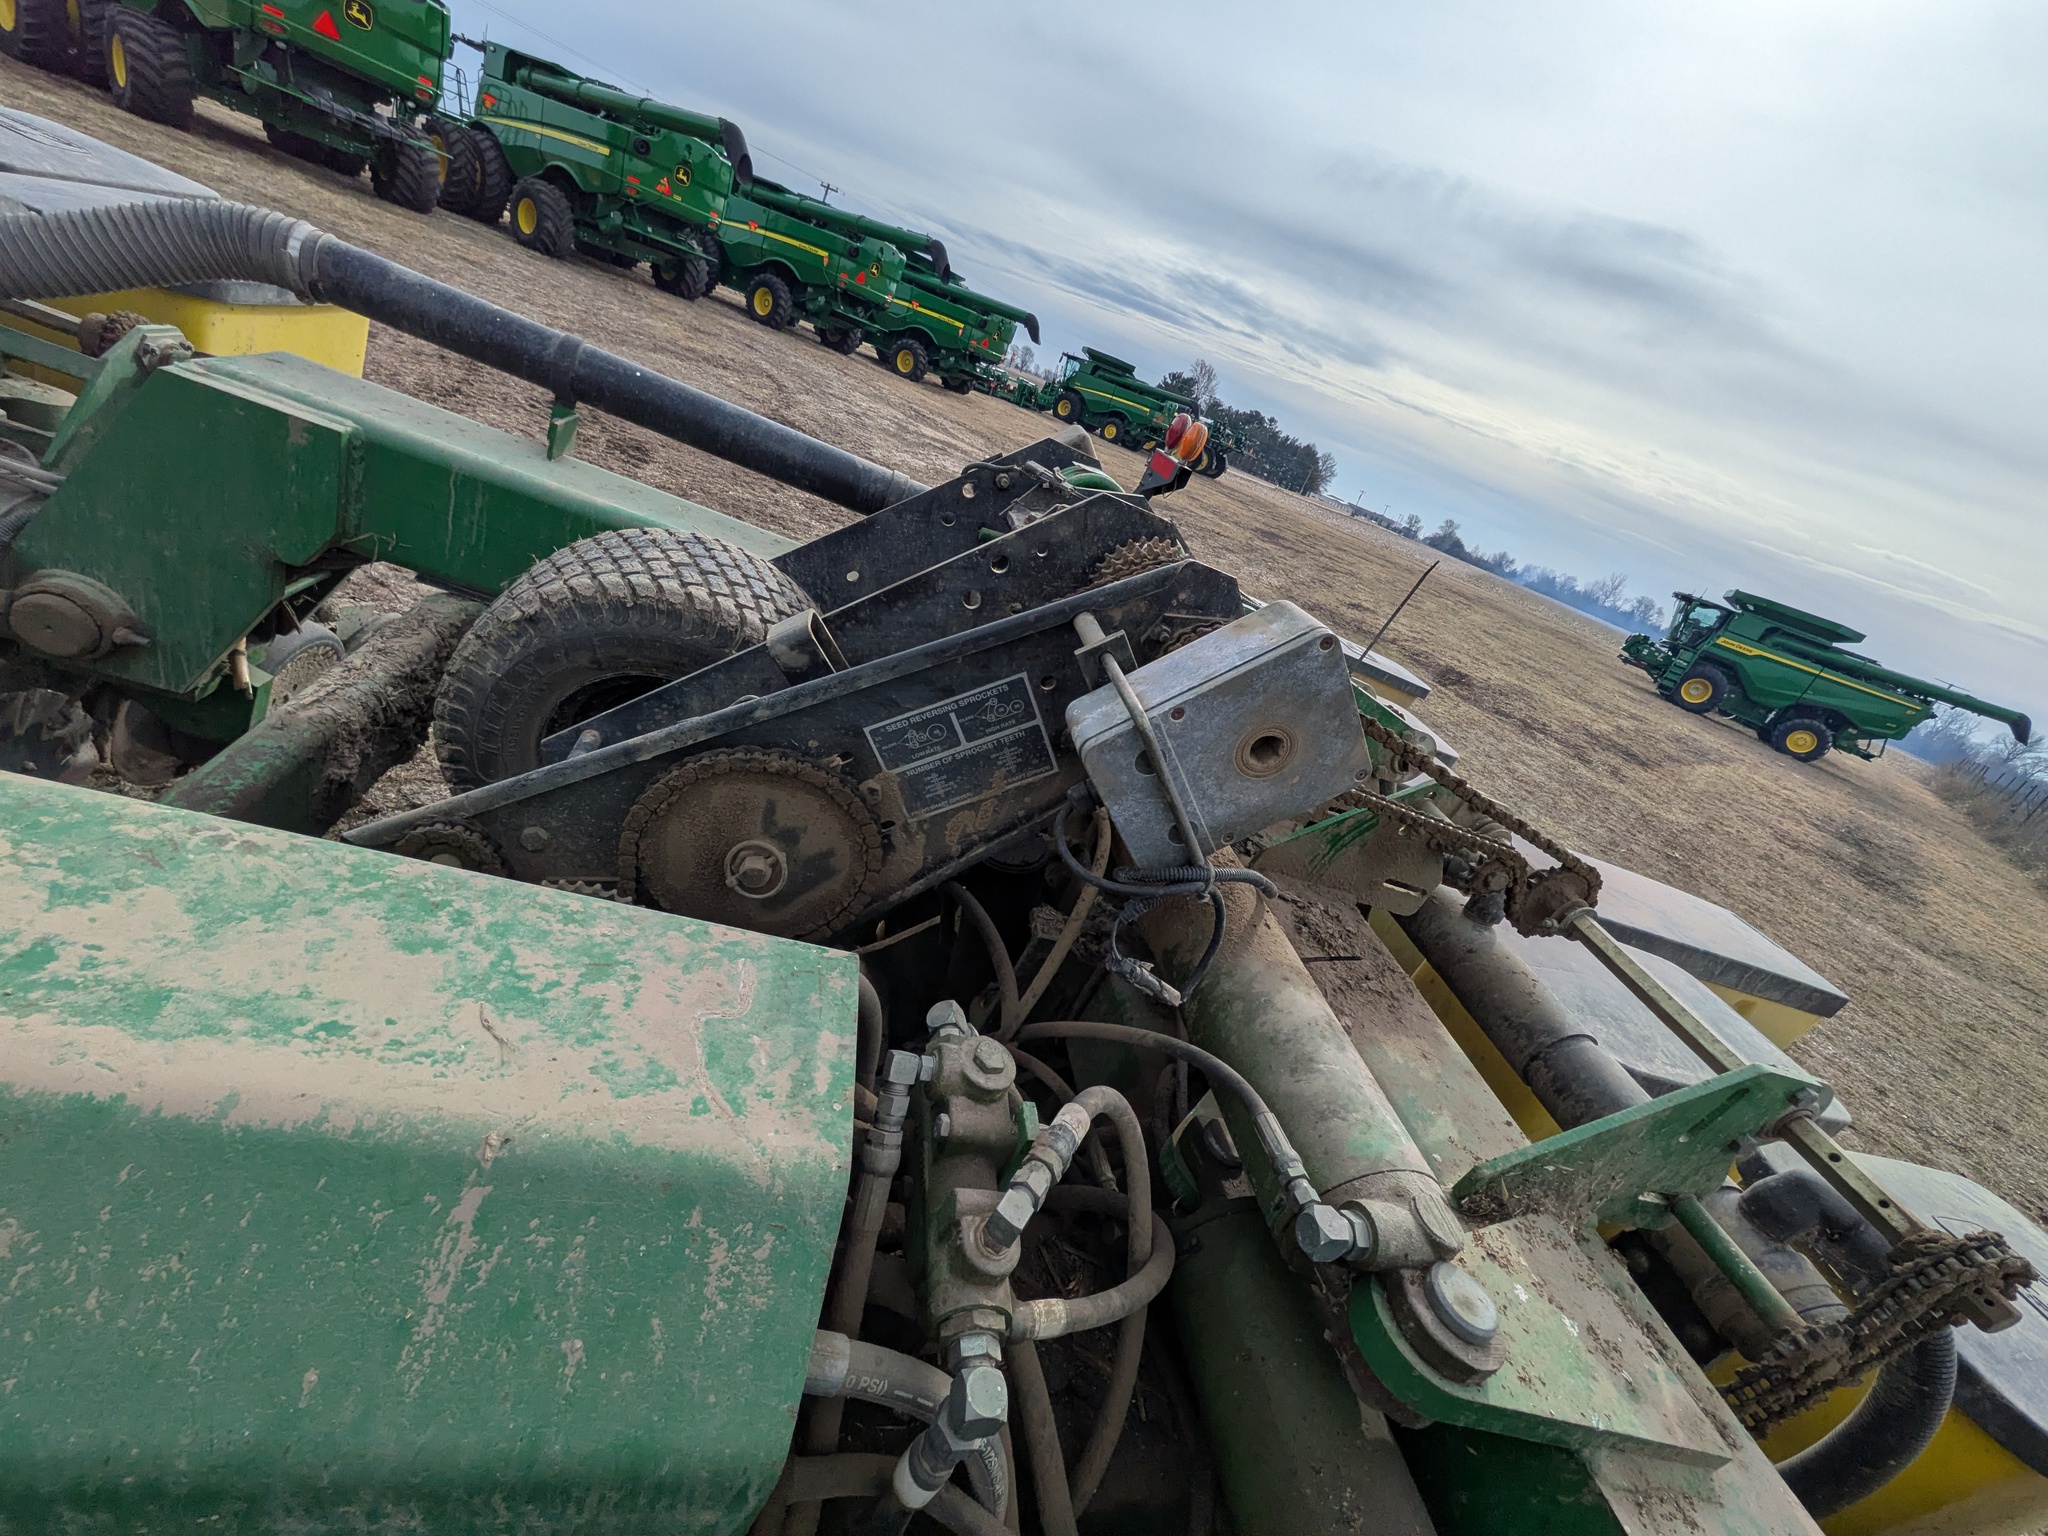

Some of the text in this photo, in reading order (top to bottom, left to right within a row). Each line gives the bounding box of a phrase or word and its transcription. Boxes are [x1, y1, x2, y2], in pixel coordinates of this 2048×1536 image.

[885, 684, 1009, 732] SEED REVERSING SPROCKETS
[985, 719, 1016, 734] HIGH RATE
[906, 730, 1026, 776] NUMBER OF SPROCKET TEETH
[857, 1376, 888, 1396] PSI)
